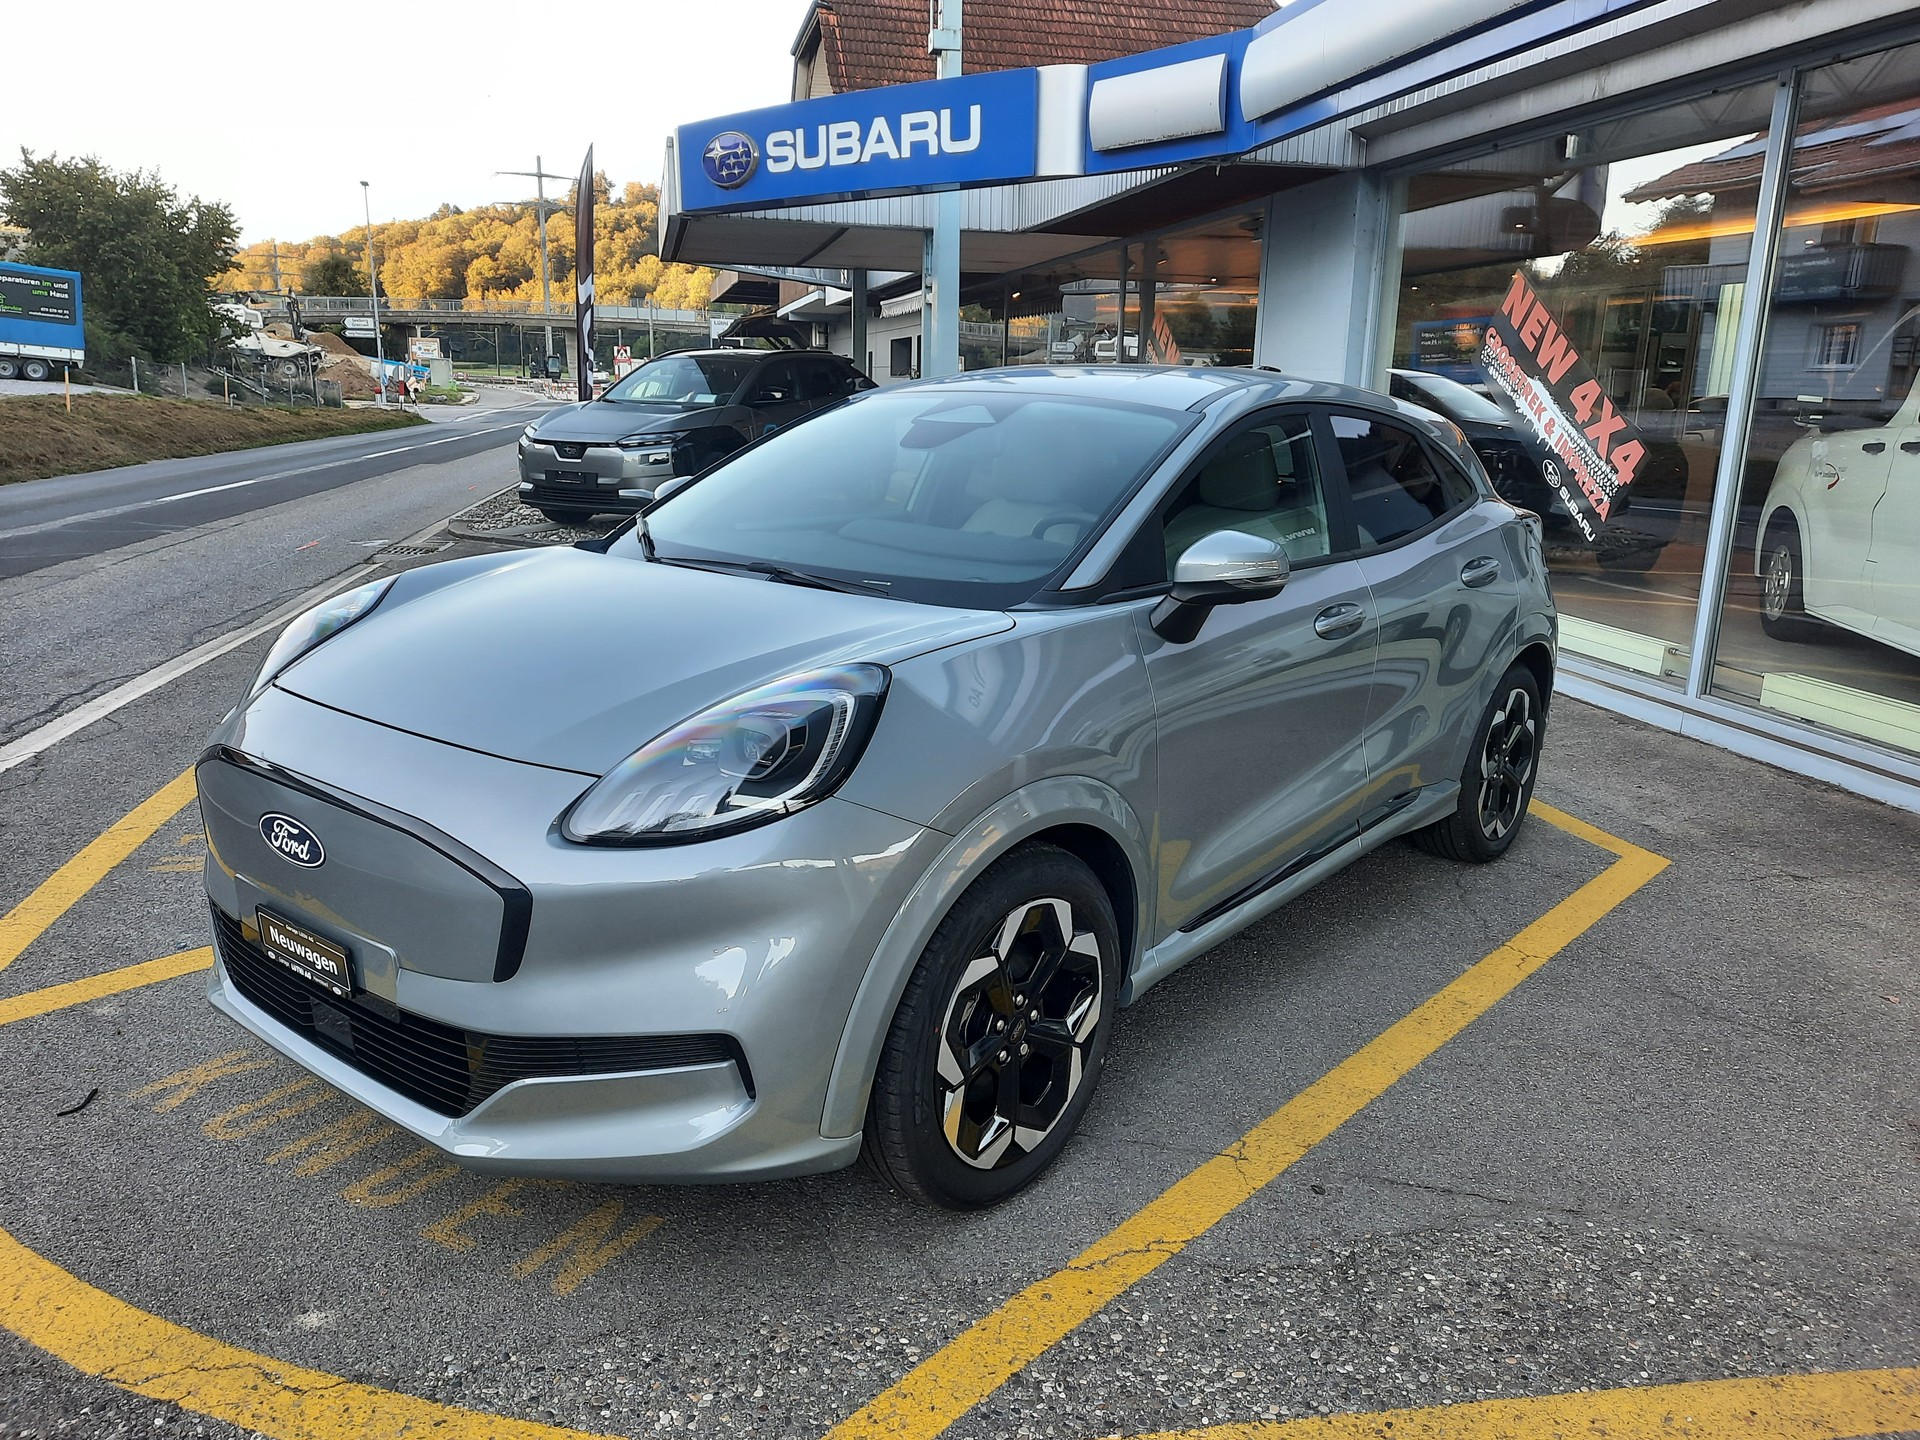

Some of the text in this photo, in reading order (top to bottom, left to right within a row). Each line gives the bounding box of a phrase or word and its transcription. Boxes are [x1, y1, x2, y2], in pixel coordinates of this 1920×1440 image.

[766, 104, 981, 174] SUBARU
[49, 290, 69, 299] Haus
[1501, 271, 1646, 487] NEW 4X4
[1485, 326, 1611, 523] CROSSTREK & IMPREZA
[1559, 485, 1596, 542] SUBARU
[271, 819, 310, 861] Ford
[269, 925, 338, 975] Neuwagen
